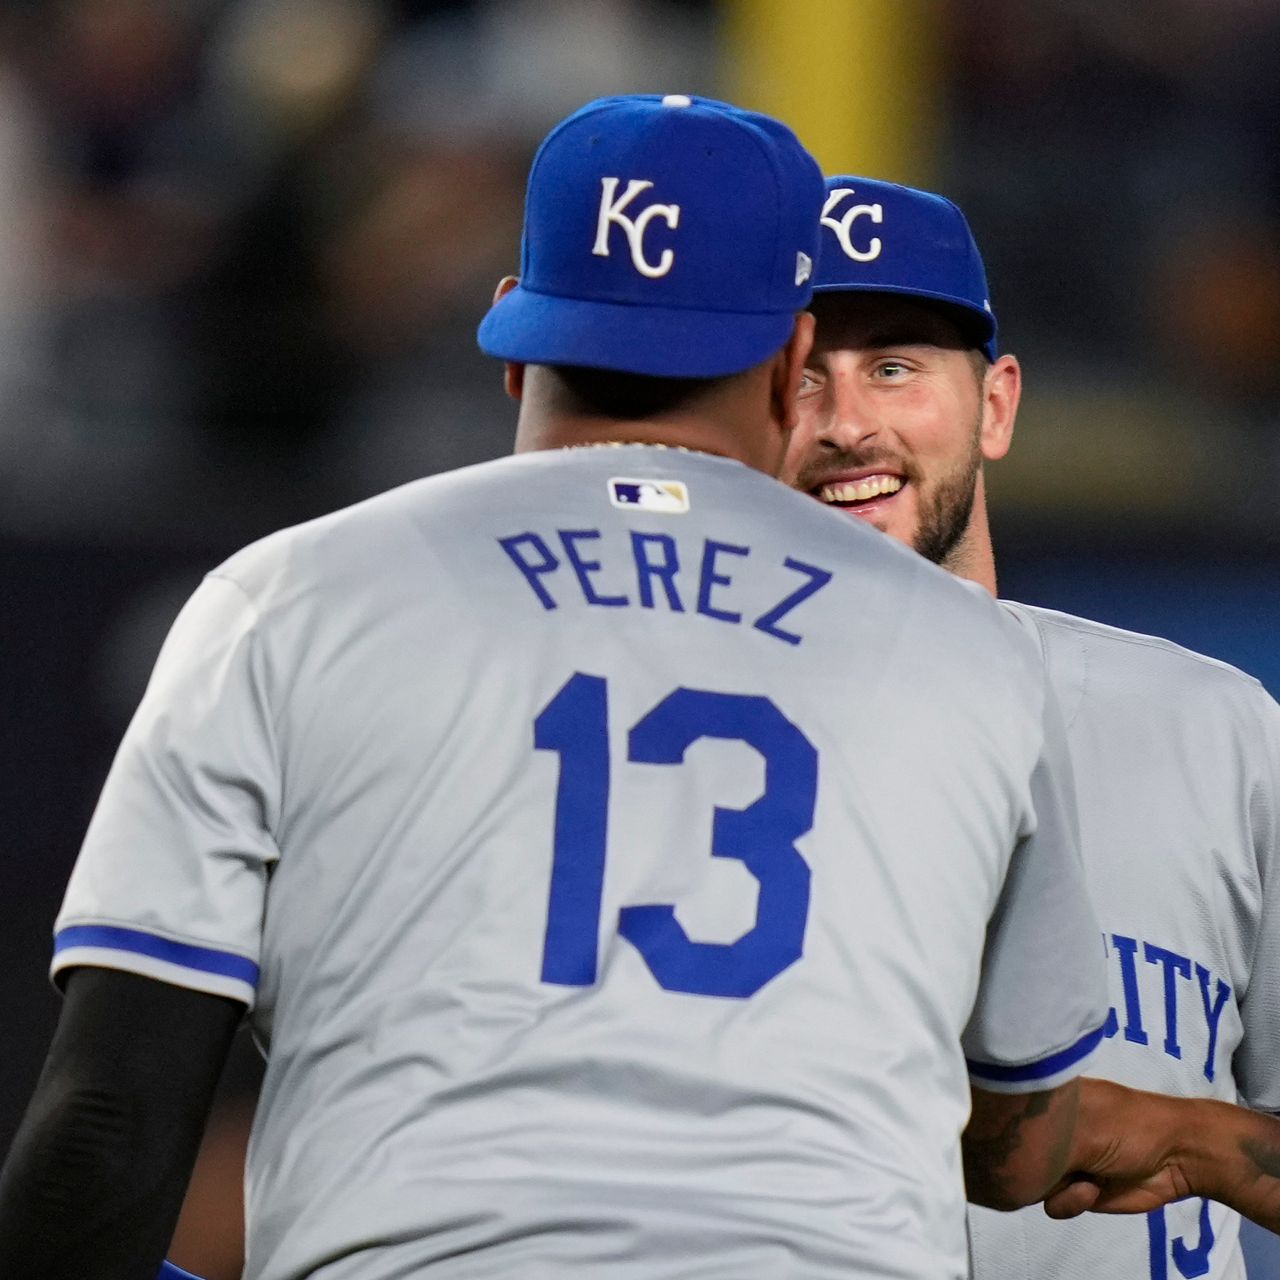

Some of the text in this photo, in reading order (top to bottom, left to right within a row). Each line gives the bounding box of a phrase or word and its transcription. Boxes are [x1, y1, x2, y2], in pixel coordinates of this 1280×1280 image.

[592, 176, 680, 278] KC
[820, 188, 883, 262] KC
[497, 529, 834, 646] PEREZ
[533, 670, 819, 1000] 13
[1100, 931, 1232, 1084] ITY
